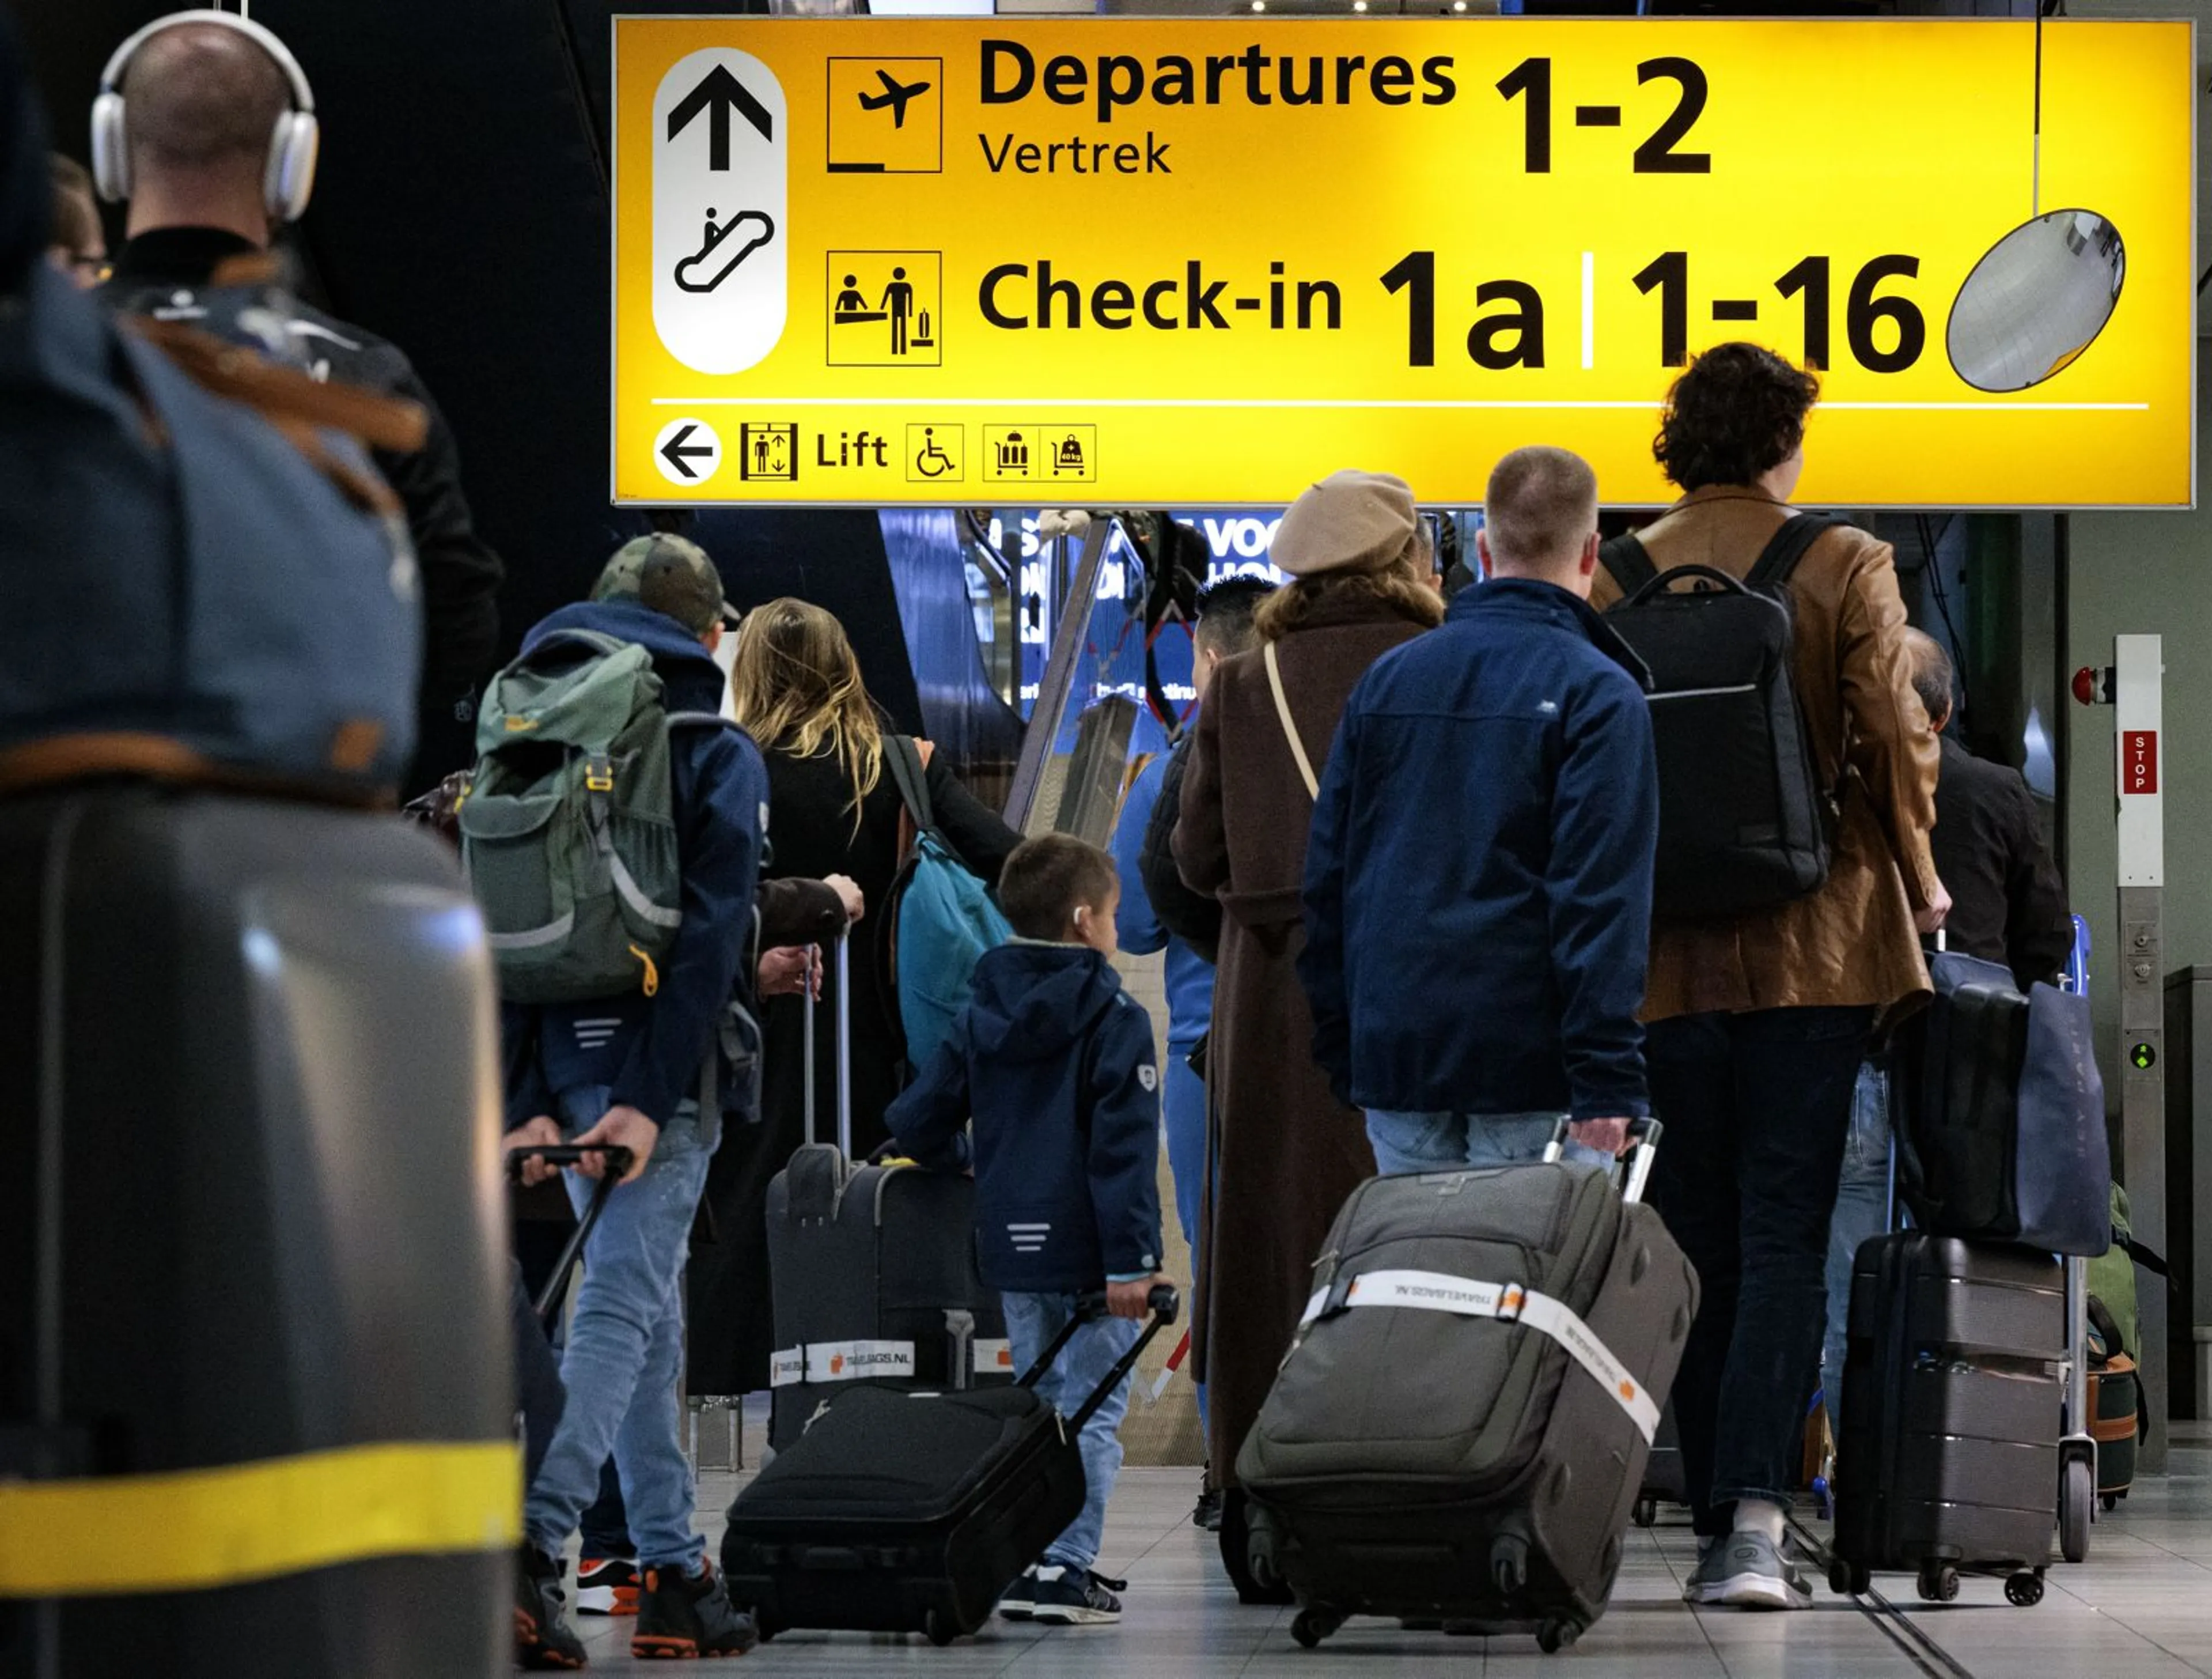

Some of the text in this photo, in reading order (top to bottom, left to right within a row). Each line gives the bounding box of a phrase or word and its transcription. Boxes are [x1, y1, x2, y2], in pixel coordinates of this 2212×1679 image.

[980, 39, 1711, 173] Departures 1-2
[978, 131, 1171, 173] Vertrek
[979, 251, 1925, 373] Check-in 1a 1-16
[818, 432, 887, 467] Lift
[2135, 737, 2145, 789] STOP
